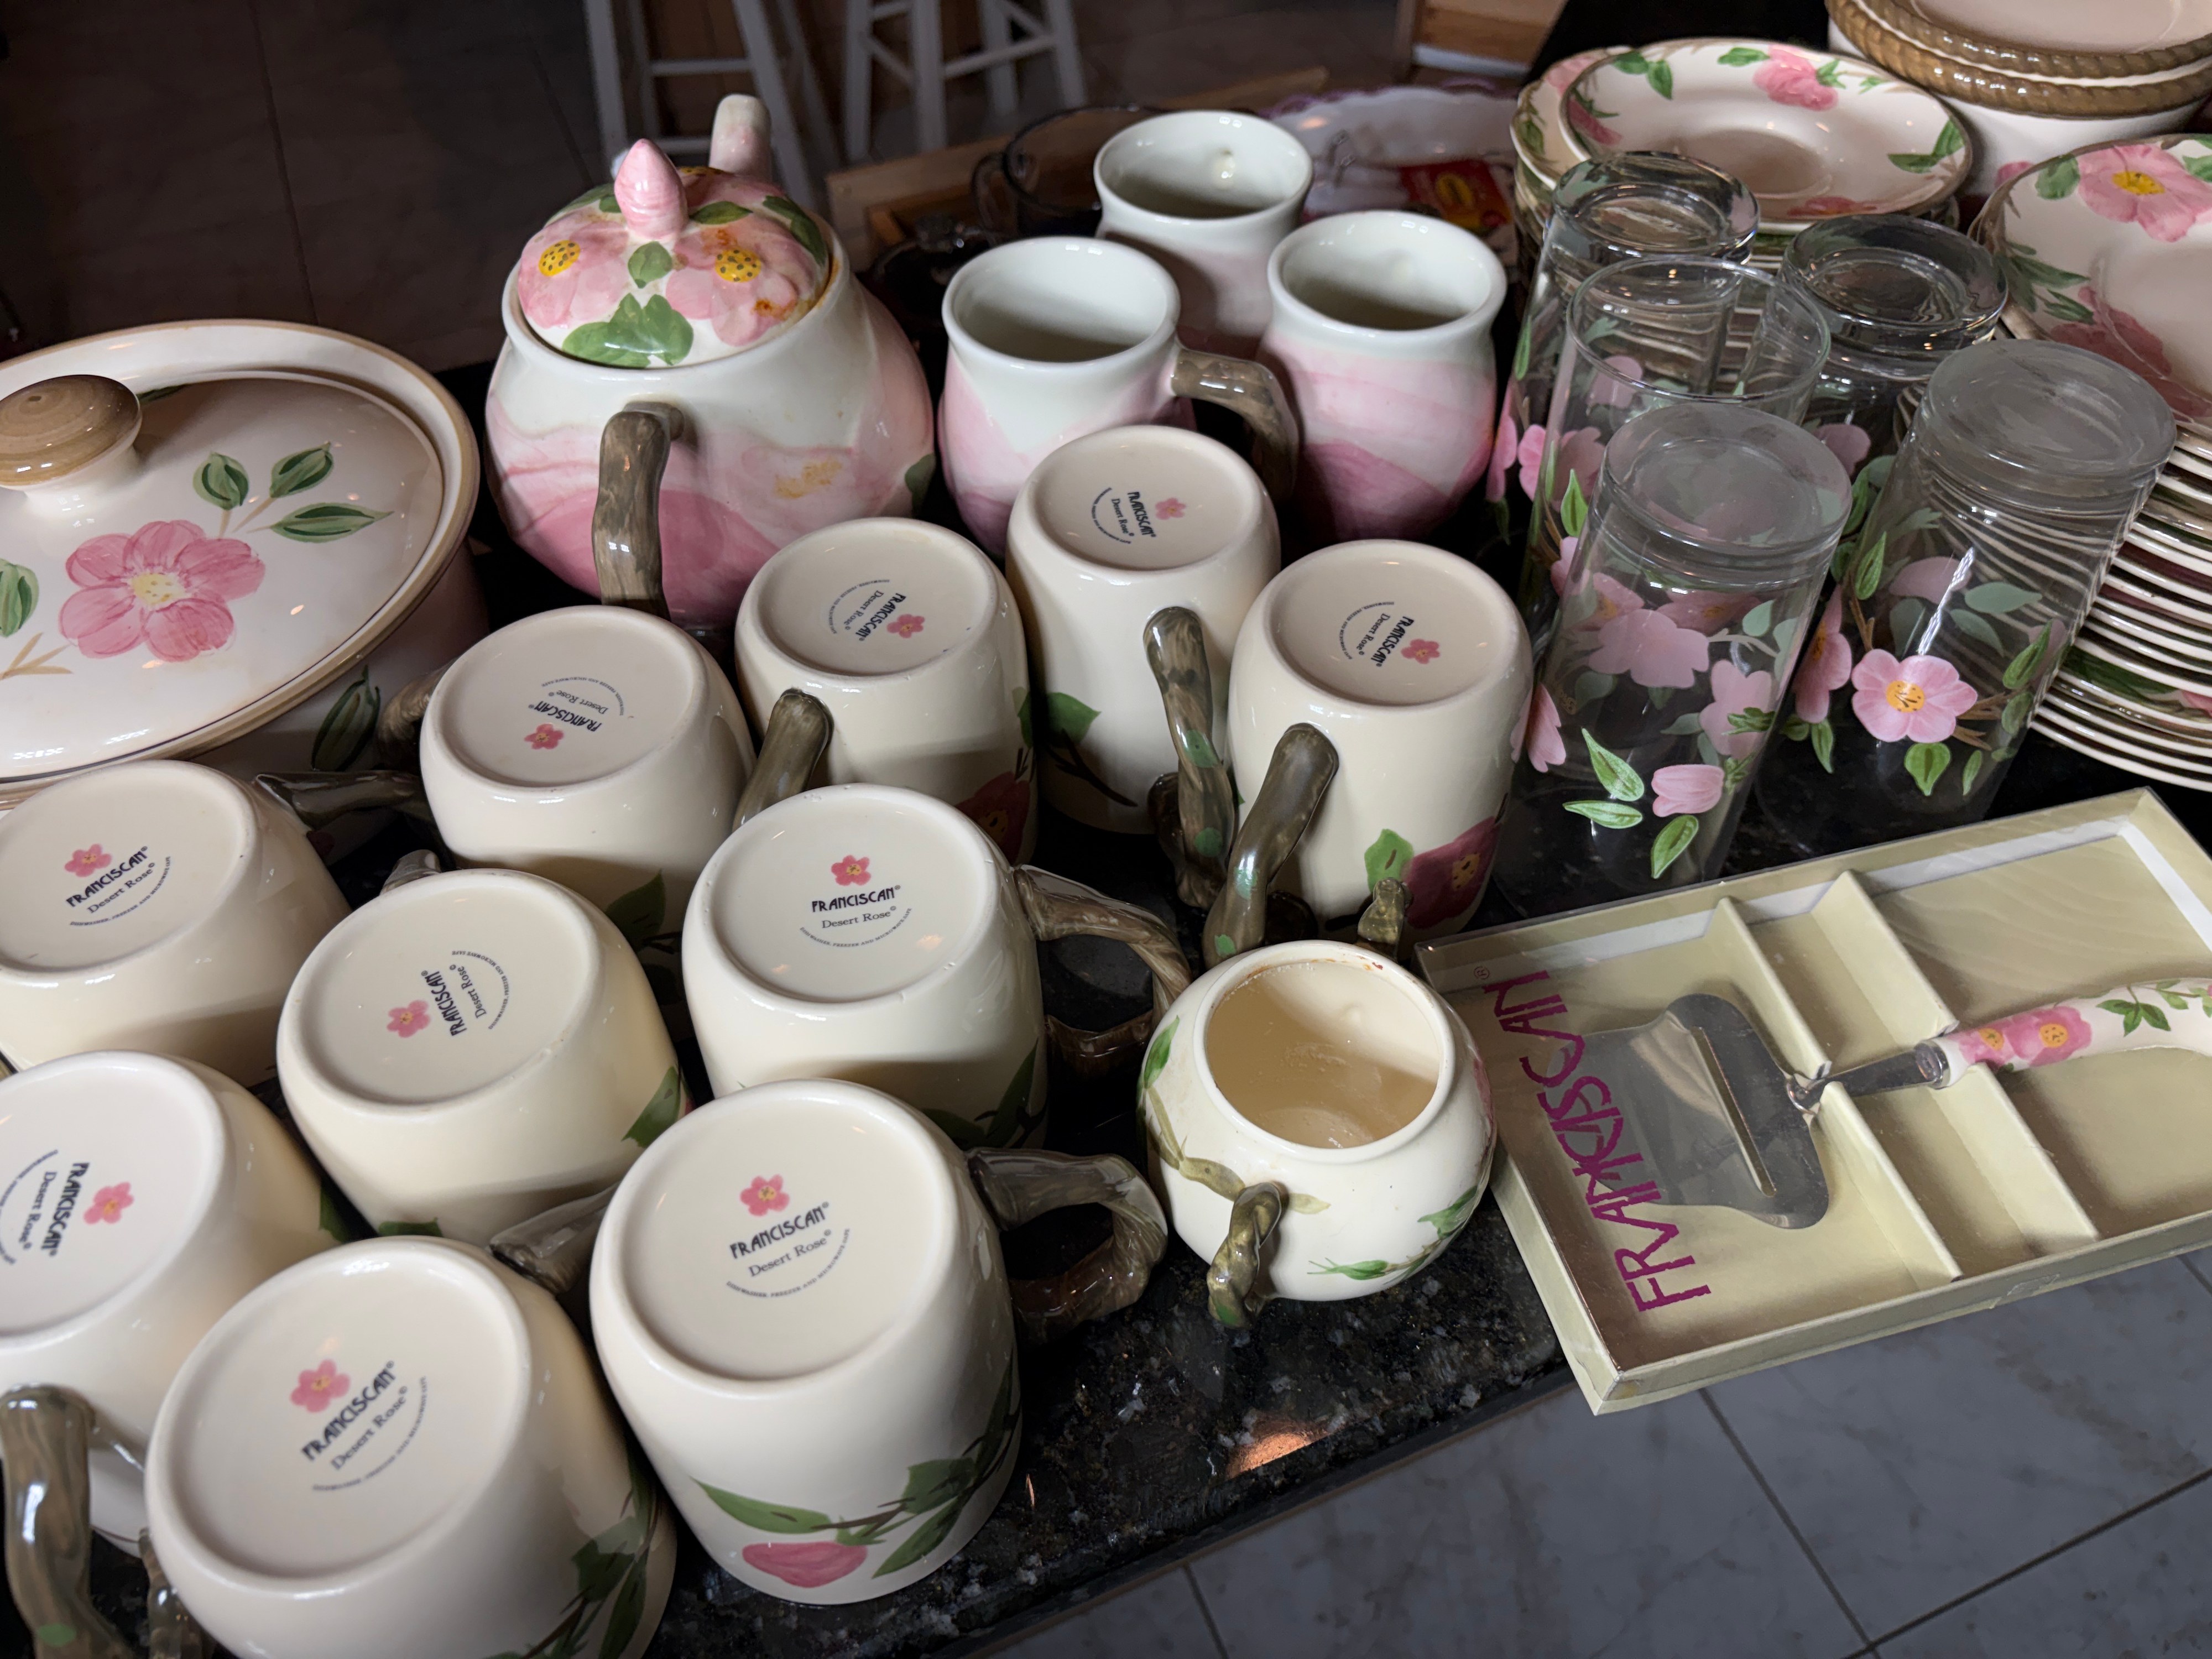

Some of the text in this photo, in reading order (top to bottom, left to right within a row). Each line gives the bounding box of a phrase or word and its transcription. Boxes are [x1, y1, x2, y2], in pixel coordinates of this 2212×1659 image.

[860, 590, 884, 611] Desert
[1369, 613, 1390, 634] Desert
[580, 699, 609, 714] Desert
[87, 888, 125, 914] Desert
[822, 917, 859, 929] Desert
[468, 989, 487, 1019] Desert
[32, 1171, 58, 1209] Desert
[748, 1253, 791, 1277] Desert
[331, 1428, 375, 1470] Desert
